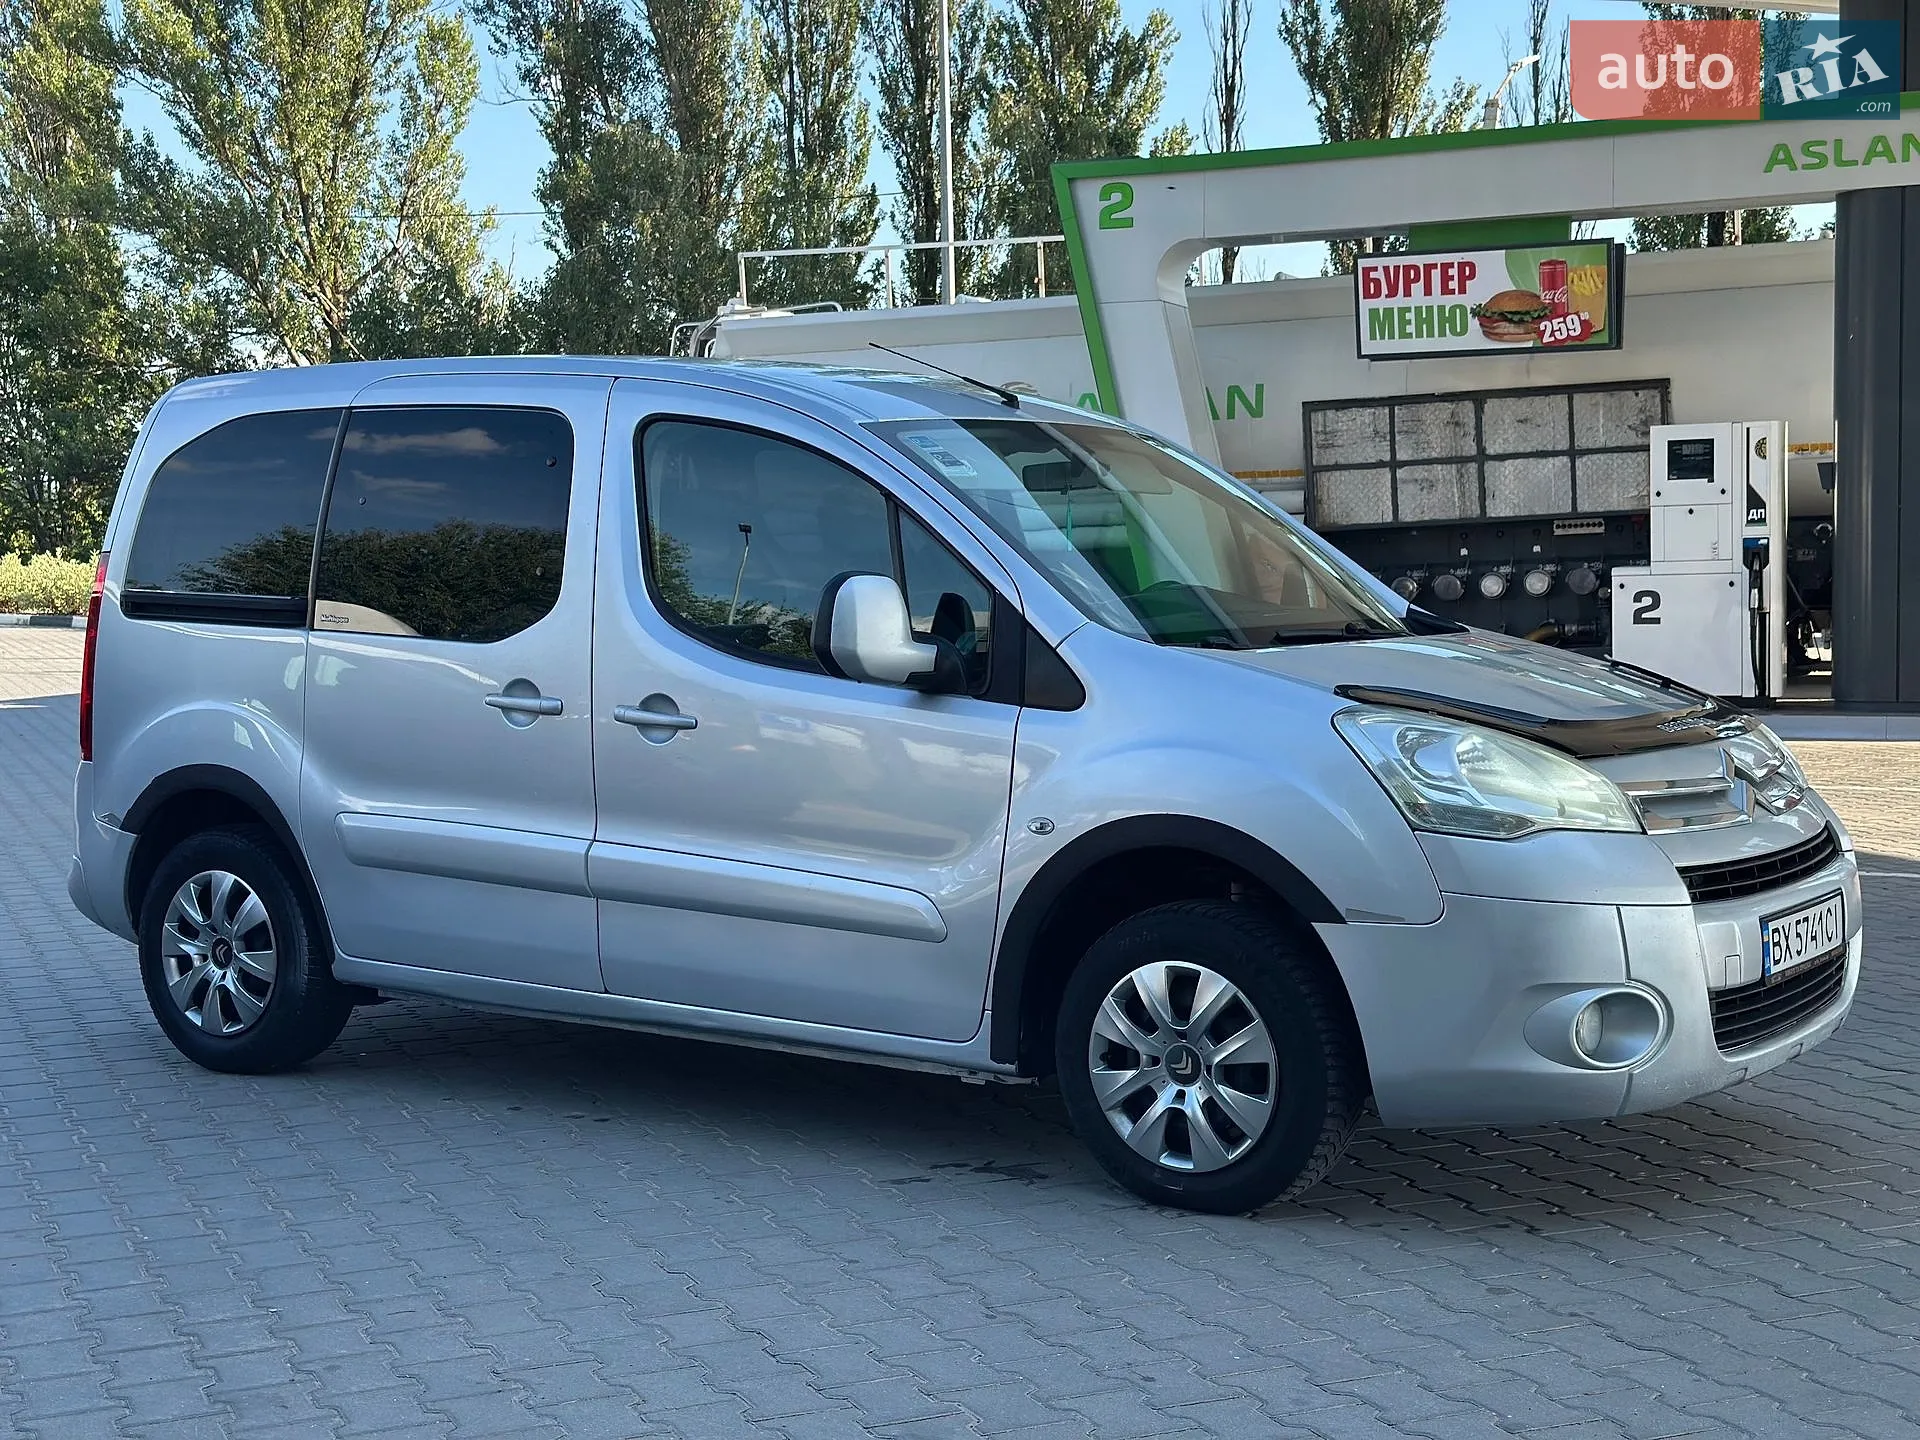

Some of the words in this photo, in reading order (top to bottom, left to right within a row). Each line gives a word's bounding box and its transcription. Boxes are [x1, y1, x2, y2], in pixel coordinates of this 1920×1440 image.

[1763, 133, 1920, 172] ASLAN
[1098, 182, 1134, 230] 2
[1362, 261, 1477, 300] БУРГЕР
[1368, 303, 1469, 341] МЕНЮ
[1540, 314, 1582, 343] 259
[1748, 508, 1766, 521] ДП
[1632, 590, 1661, 625] 2
